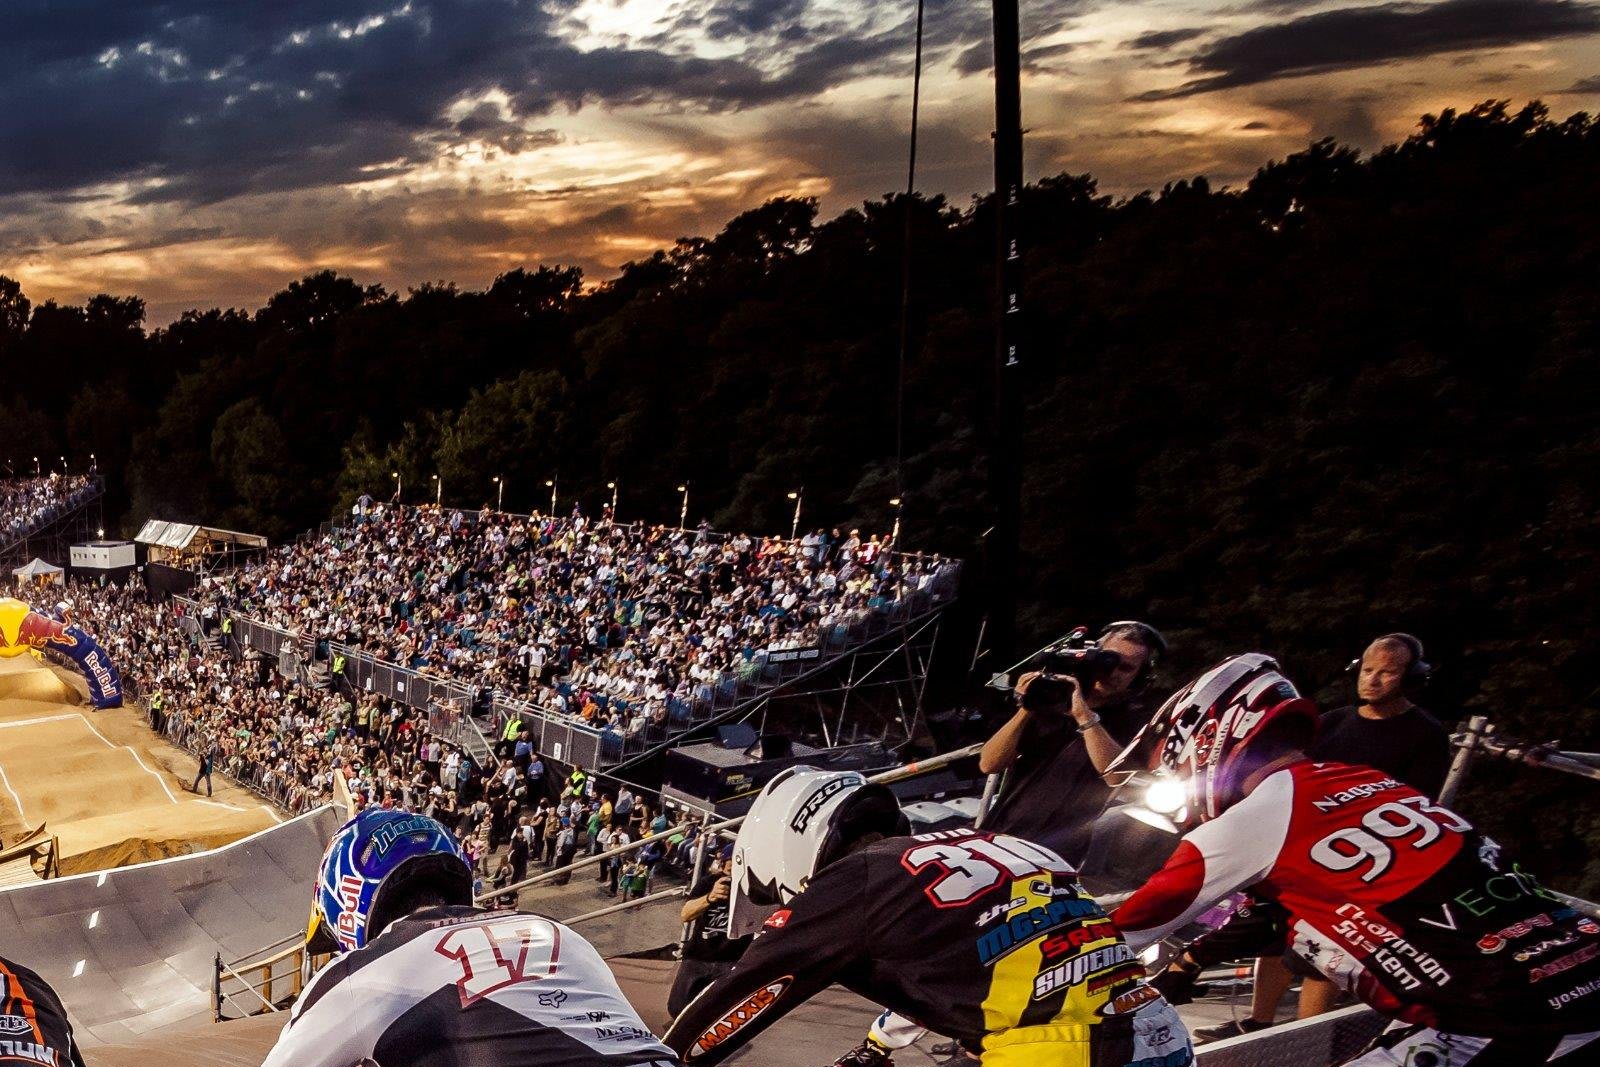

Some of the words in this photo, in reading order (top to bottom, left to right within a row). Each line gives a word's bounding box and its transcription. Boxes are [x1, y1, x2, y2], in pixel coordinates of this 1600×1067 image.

[906, 834, 1077, 904] 310
[1310, 795, 1473, 882] 993
[975, 897, 1028, 926] the
[1335, 902, 1450, 987] Champion
[1331, 919, 1421, 991] System
[698, 987, 776, 1053] MAXXIS
